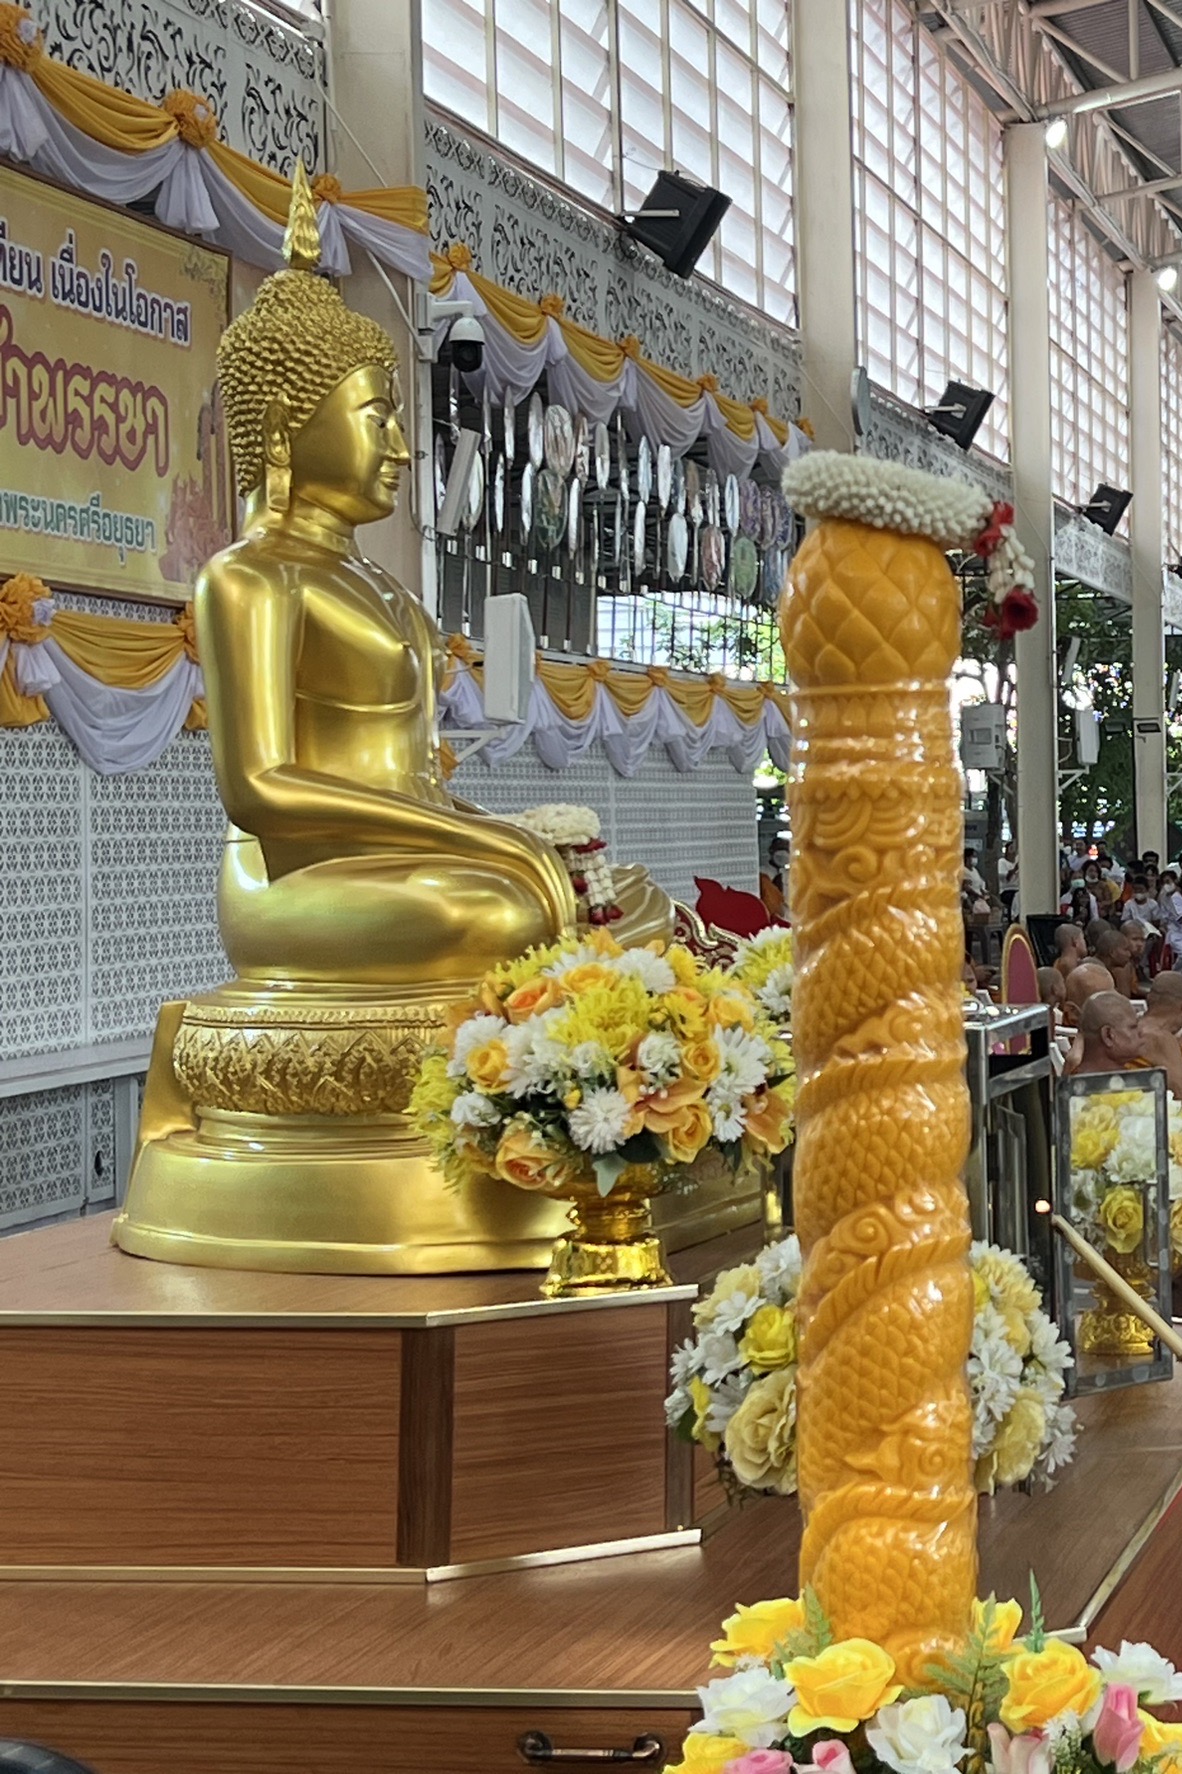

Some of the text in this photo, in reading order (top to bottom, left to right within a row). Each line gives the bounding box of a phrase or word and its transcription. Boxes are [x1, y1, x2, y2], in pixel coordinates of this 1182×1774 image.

[51, 231, 189, 343] เนื่องในโอกาส
[0, 304, 169, 478] ้าพรรษา
[0, 492, 156, 563] พระนครศรีอยุธยา
